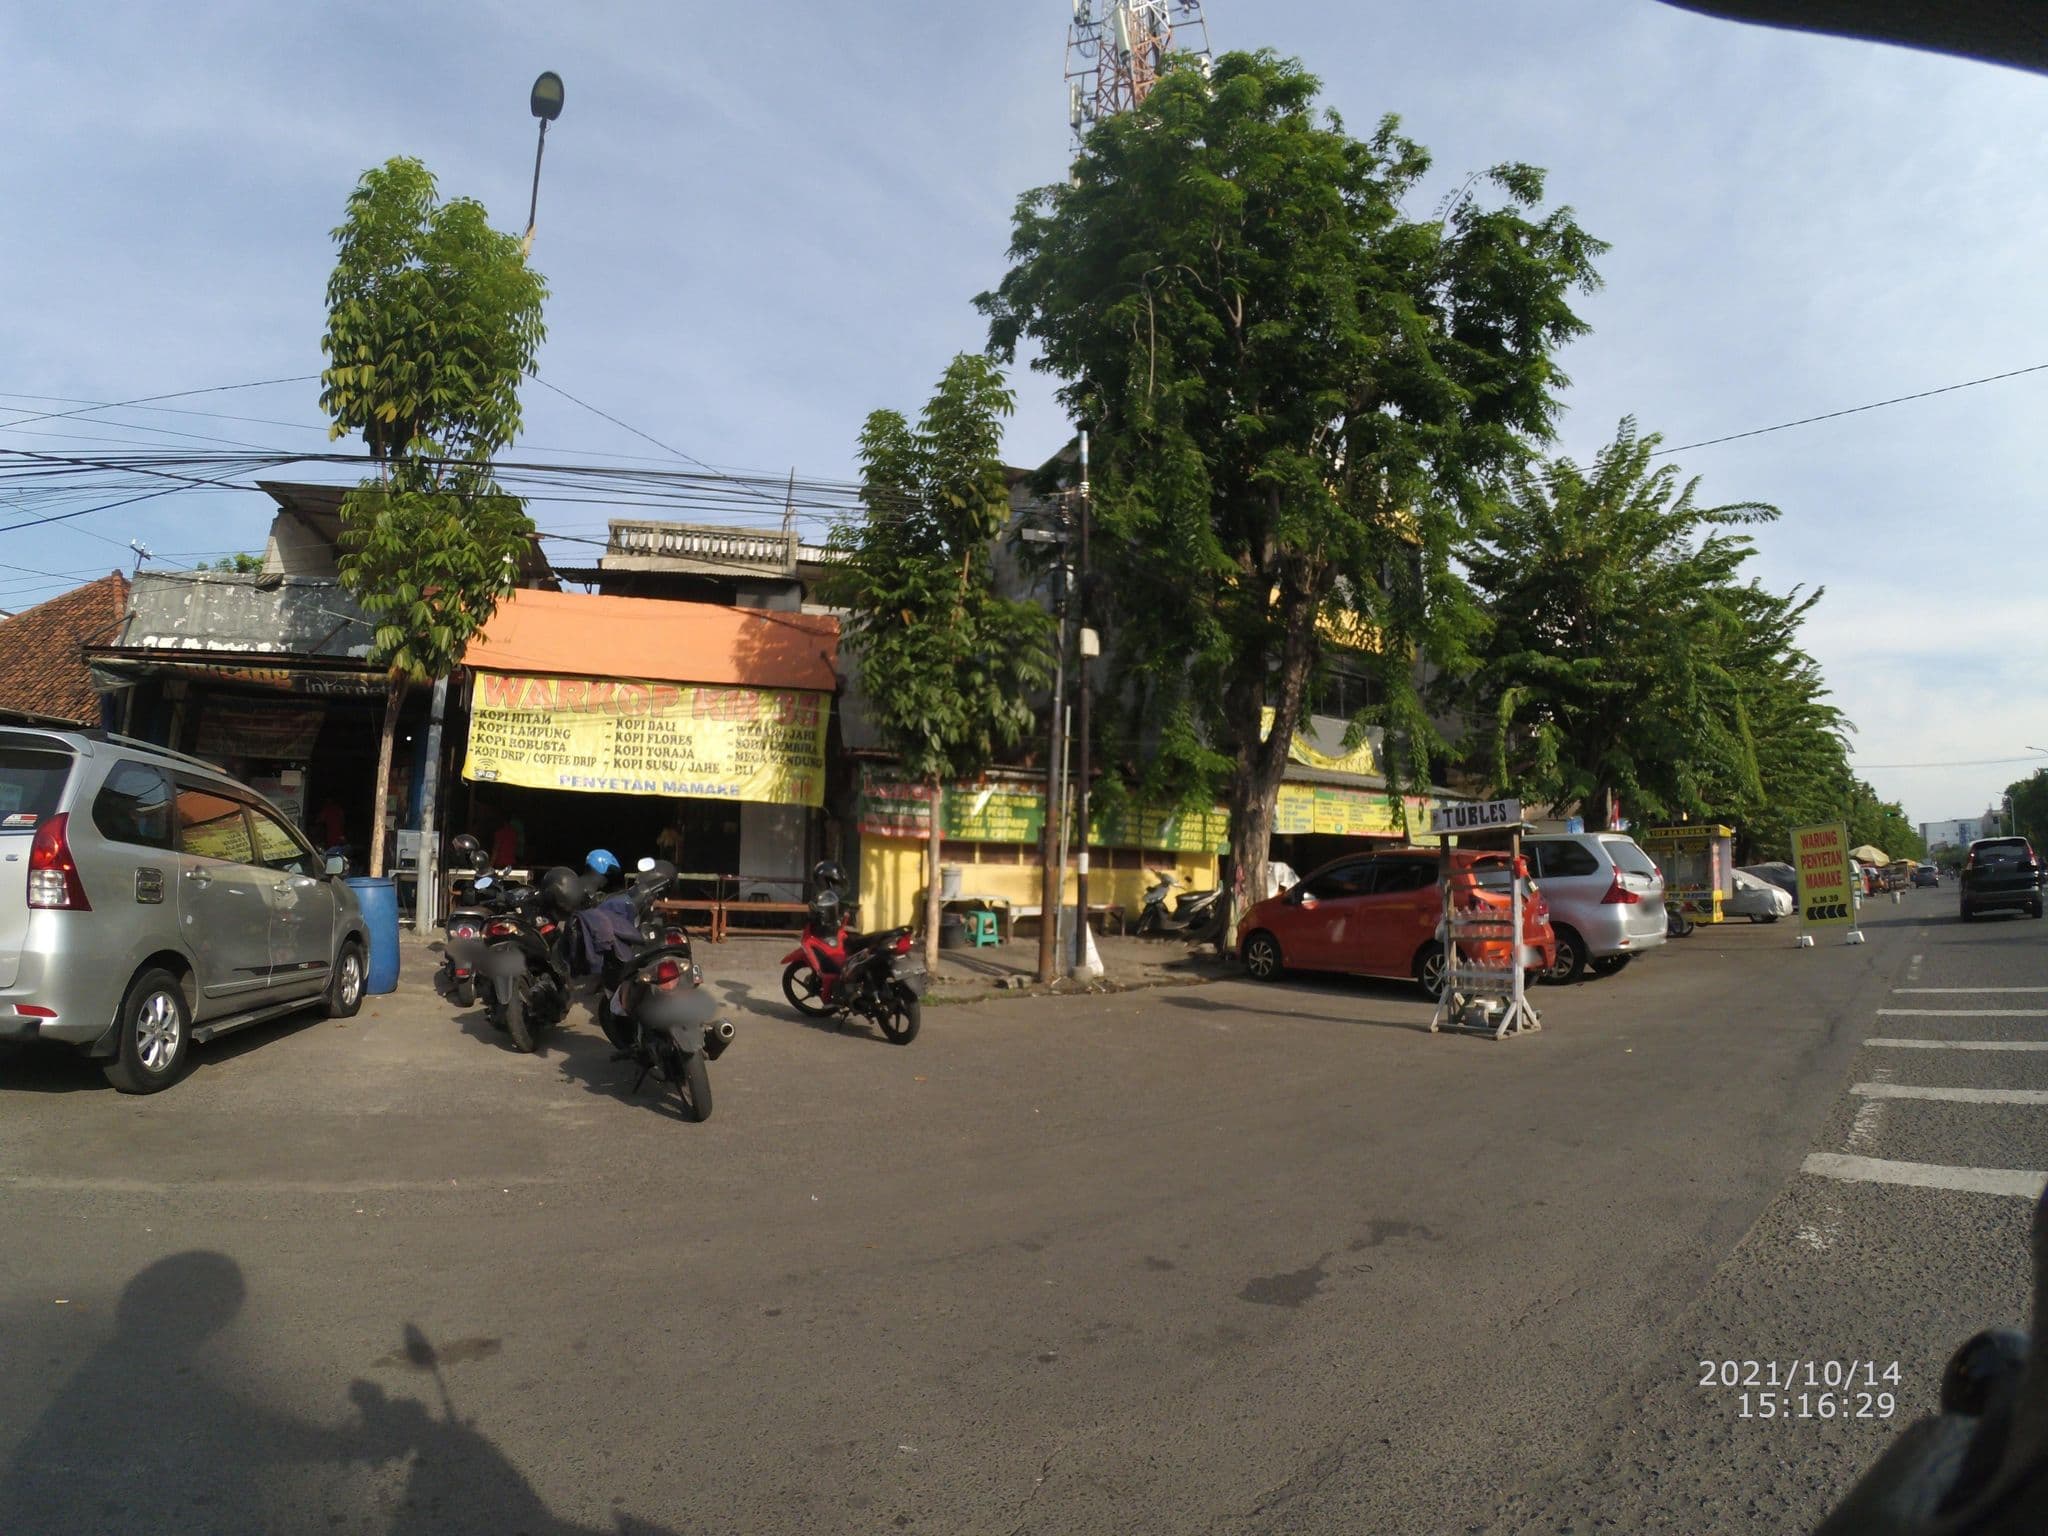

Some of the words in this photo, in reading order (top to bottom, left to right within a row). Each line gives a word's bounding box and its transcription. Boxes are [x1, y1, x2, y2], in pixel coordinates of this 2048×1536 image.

[484, 674, 680, 718] WARKOP
[479, 709, 509, 722] KOPI
[511, 712, 552, 725] HITAM
[616, 719, 645, 730] KOPI
[477, 721, 507, 732] KOPI
[510, 726, 572, 740] LAMPUNG
[615, 732, 644, 743] KOPI
[647, 734, 693, 746] FLORES
[476, 733, 506, 746] KOPI
[509, 738, 567, 752] ROBUSTA
[614, 745, 643, 756] KOPI
[646, 747, 695, 759] TORAJA
[474, 746, 499, 758] KOPI
[501, 750, 526, 761] DRIP
[533, 752, 571, 765] COFFEE
[573, 755, 597, 767] DRIP
[613, 759, 643, 770] KOPI
[645, 760, 678, 771] SUSU
[688, 762, 720, 774] JAHE
[559, 775, 657, 792] PENYETAN
[663, 781, 740, 796] MAMAKE
[1442, 803, 1507, 828] TUBLES
[1800, 830, 1838, 849] WARUNG
[1801, 849, 1843, 870] PENYETAN
[1805, 870, 1843, 889] MAMAKE
[1829, 894, 1839, 902] 39
